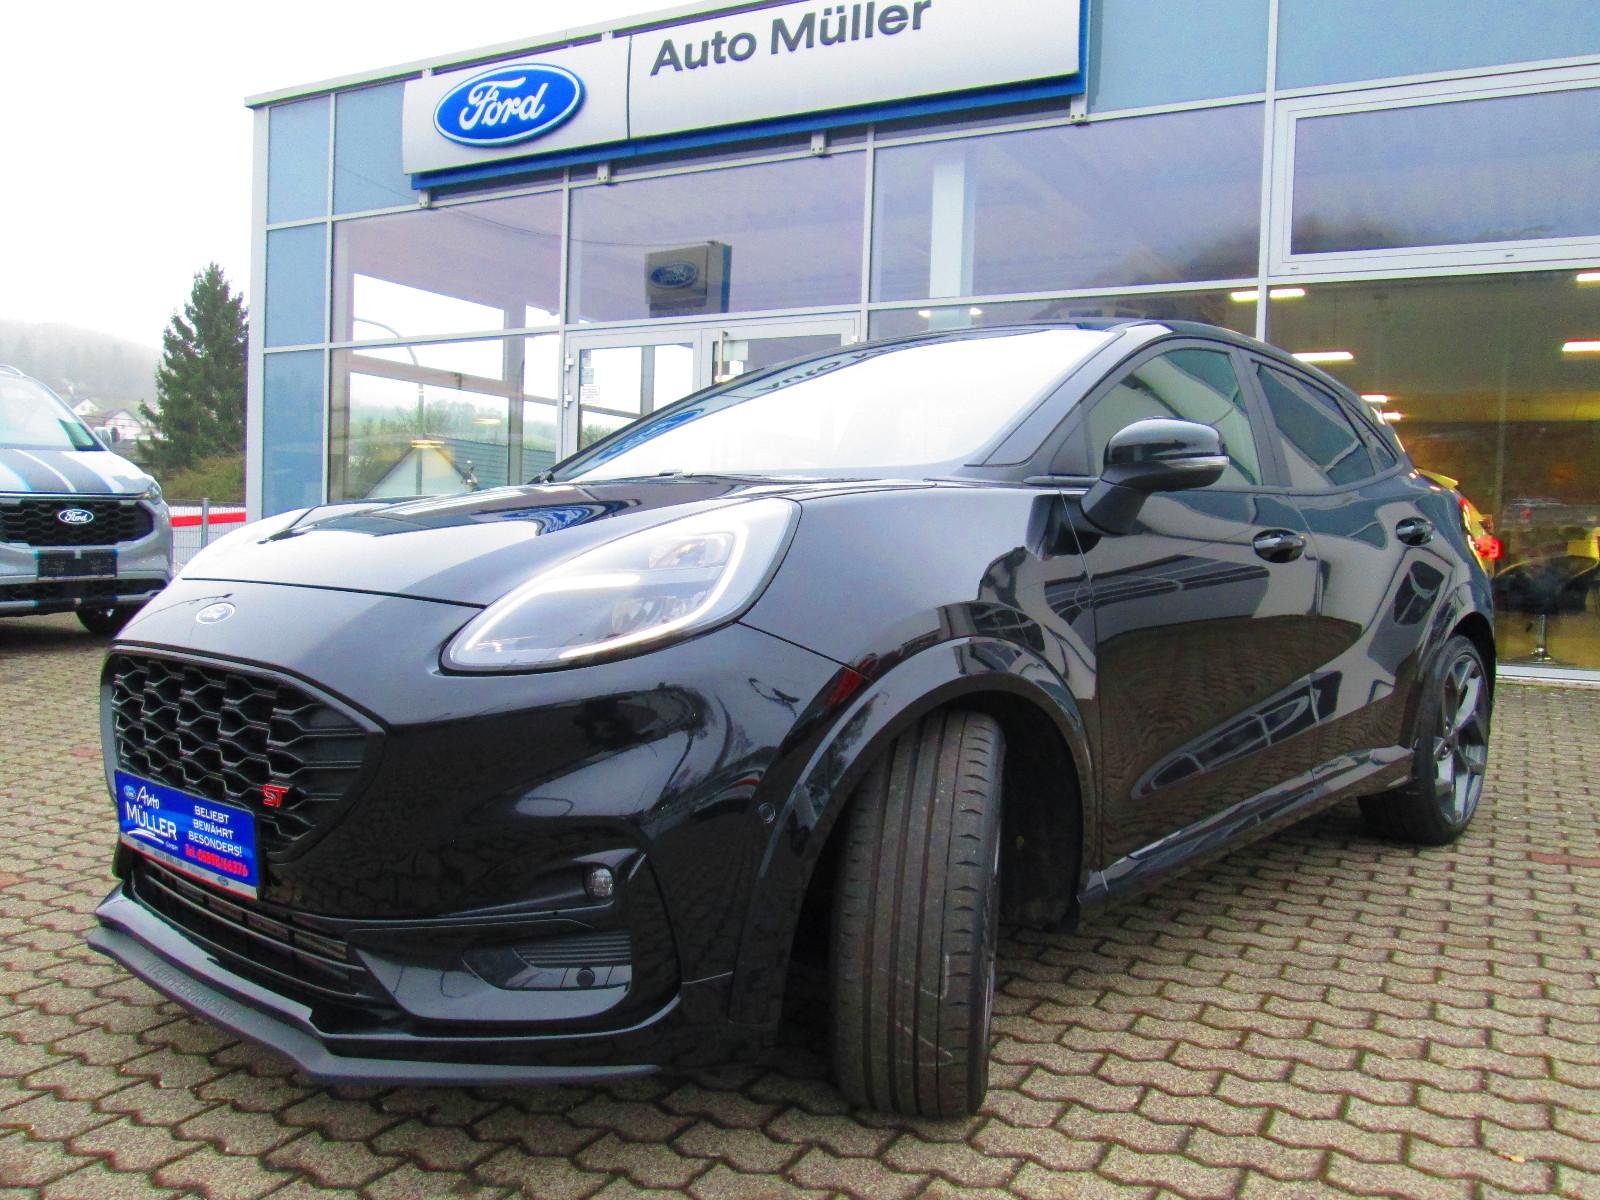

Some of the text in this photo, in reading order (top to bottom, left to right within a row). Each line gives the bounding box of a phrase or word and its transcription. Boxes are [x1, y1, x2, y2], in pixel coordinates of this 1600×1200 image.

[650, 0, 932, 76] Auto Müller
[459, 76, 549, 130] Ford
[261, 783, 289, 808] ST
[126, 800, 178, 841] MÜLLER
[194, 805, 230, 824] BELIEBT
[192, 818, 234, 840] BEWÄHRT
[188, 830, 243, 858] BESONDERS!
